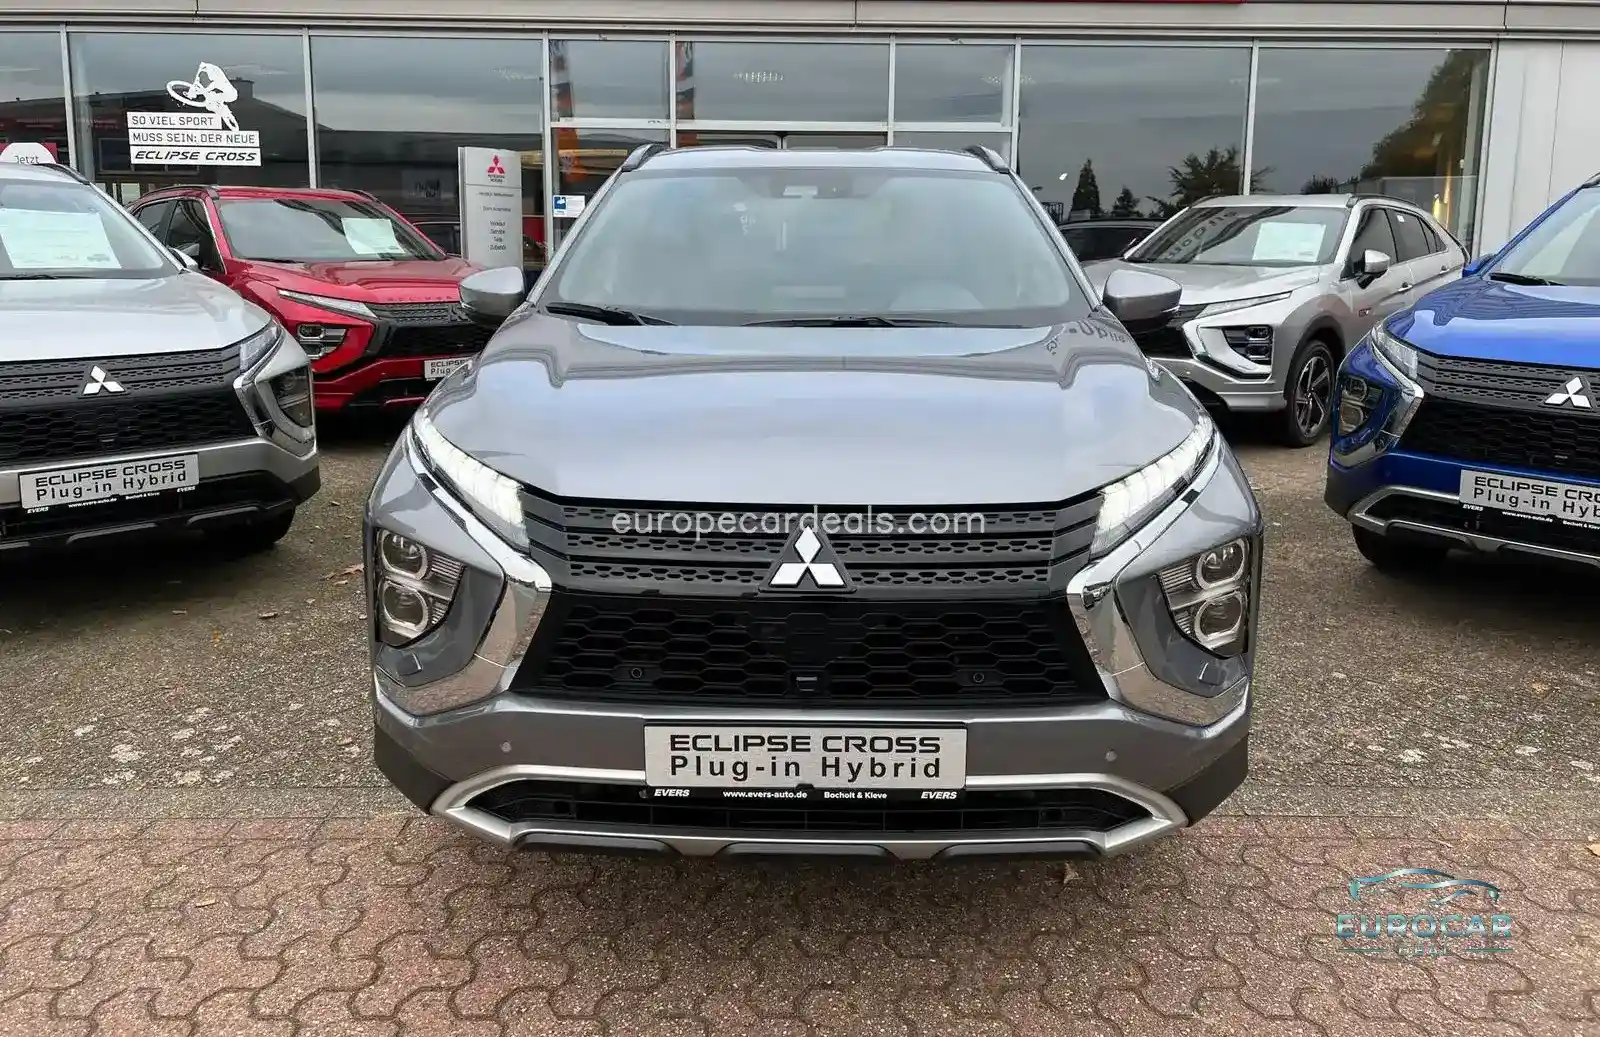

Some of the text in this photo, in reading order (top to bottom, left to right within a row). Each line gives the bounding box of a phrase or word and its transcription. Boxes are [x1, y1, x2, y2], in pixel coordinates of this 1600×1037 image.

[132, 115, 214, 126] SO VIEL SPORT
[133, 132, 255, 144] MUSS SEIN: DER NEUE
[135, 150, 257, 161] ECLIPSE CROSS
[35, 459, 185, 488] ECLIPSE CROSS
[36, 470, 187, 500] Plug-in Hybrid
[1474, 476, 1558, 497] ECLIPSE
[1473, 488, 1550, 509] Plug-in
[669, 734, 941, 753] ECLIPSE CROSS
[670, 755, 940, 783] Plug-in Hybrid
[654, 788, 690, 797] EVERS
[723, 790, 808, 799] www.evers-auto.de
[824, 791, 855, 799] Bocholt
[921, 791, 957, 800] EVERS
